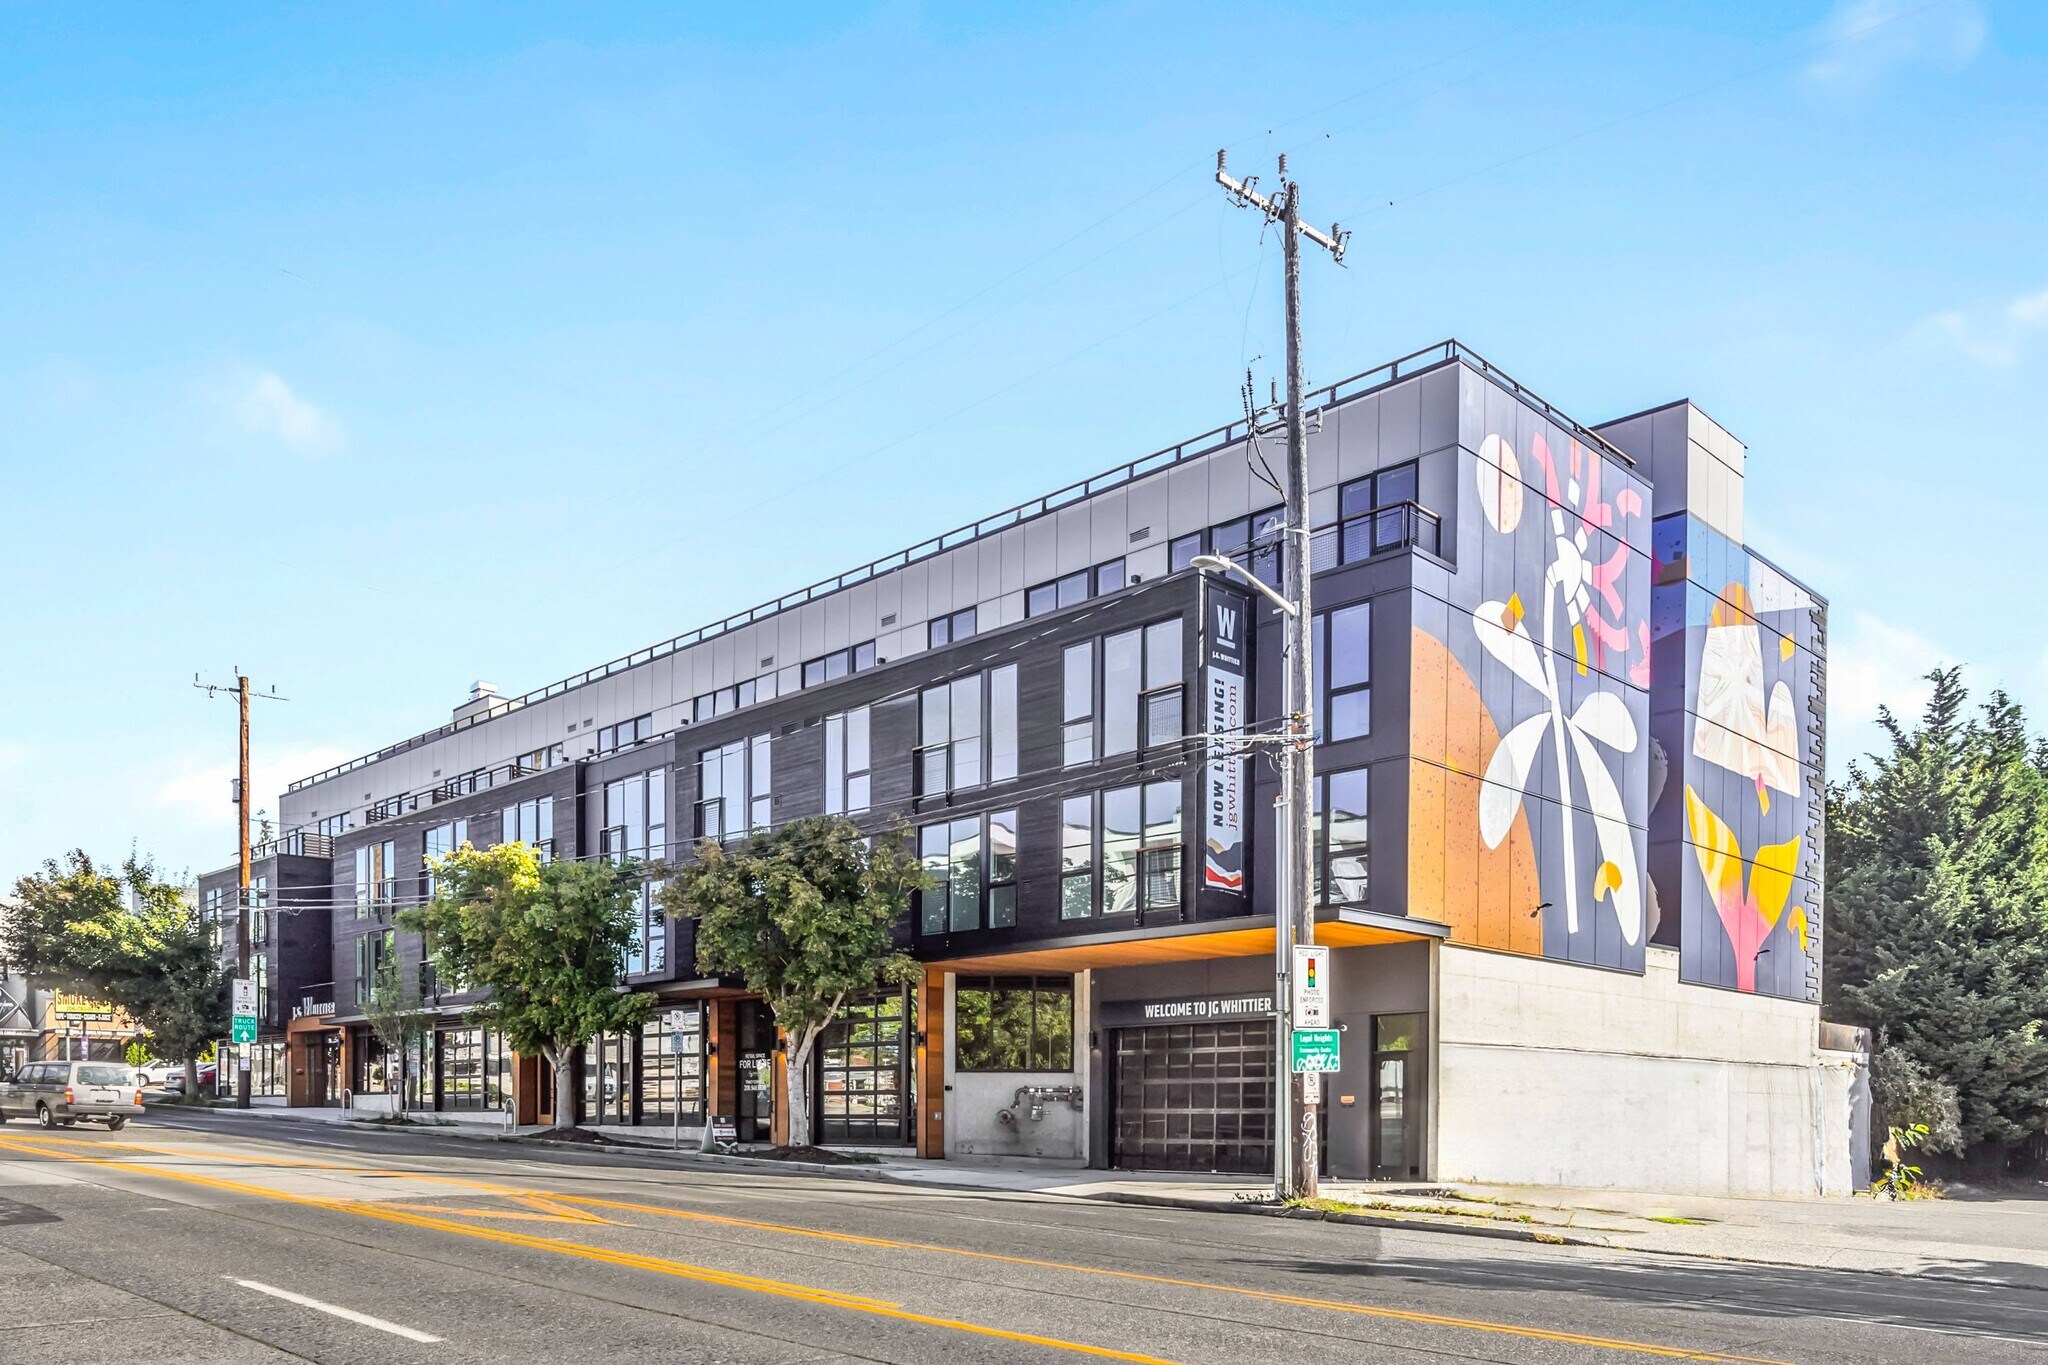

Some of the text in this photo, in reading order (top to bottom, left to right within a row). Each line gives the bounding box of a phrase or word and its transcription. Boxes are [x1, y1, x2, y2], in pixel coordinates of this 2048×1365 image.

[1217, 604, 1236, 640] W
[1213, 678, 1224, 828] NOW LEASING!
[1226, 685, 1238, 831] jgwhitte.com
[1145, 997, 1272, 1018] WELCOME TO JG WHITTIER
[739, 1059, 751, 1068] FOR
